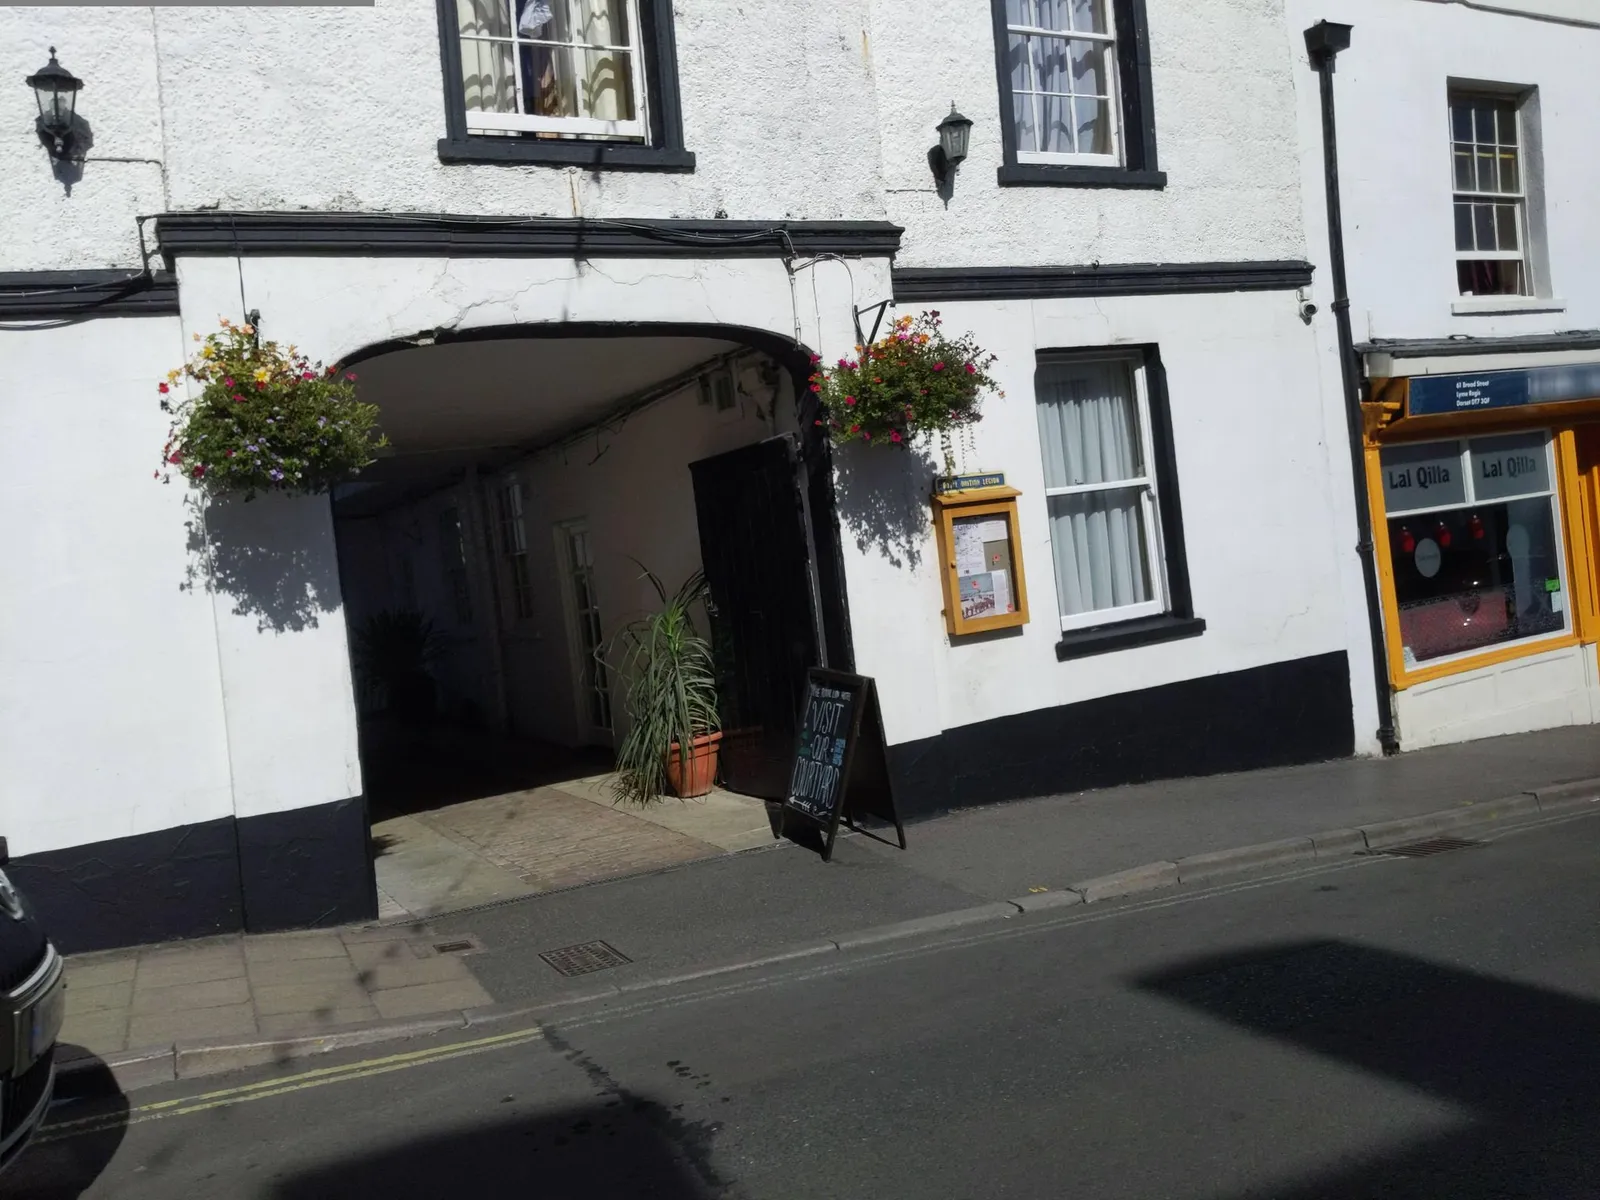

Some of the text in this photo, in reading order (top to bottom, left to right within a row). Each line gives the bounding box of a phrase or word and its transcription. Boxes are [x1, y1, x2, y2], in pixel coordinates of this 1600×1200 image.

[1456, 389, 1481, 399] Lyme Regis
[1462, 380, 1476, 388] Broad
[1456, 399, 1470, 407] Dorset
[1389, 465, 1450, 490] Lal Qilla
[1482, 455, 1537, 478] Lal Qilla
[812, 701, 844, 734] VISIT
[811, 734, 831, 763] OUR
[791, 755, 840, 809] COURTYARD
